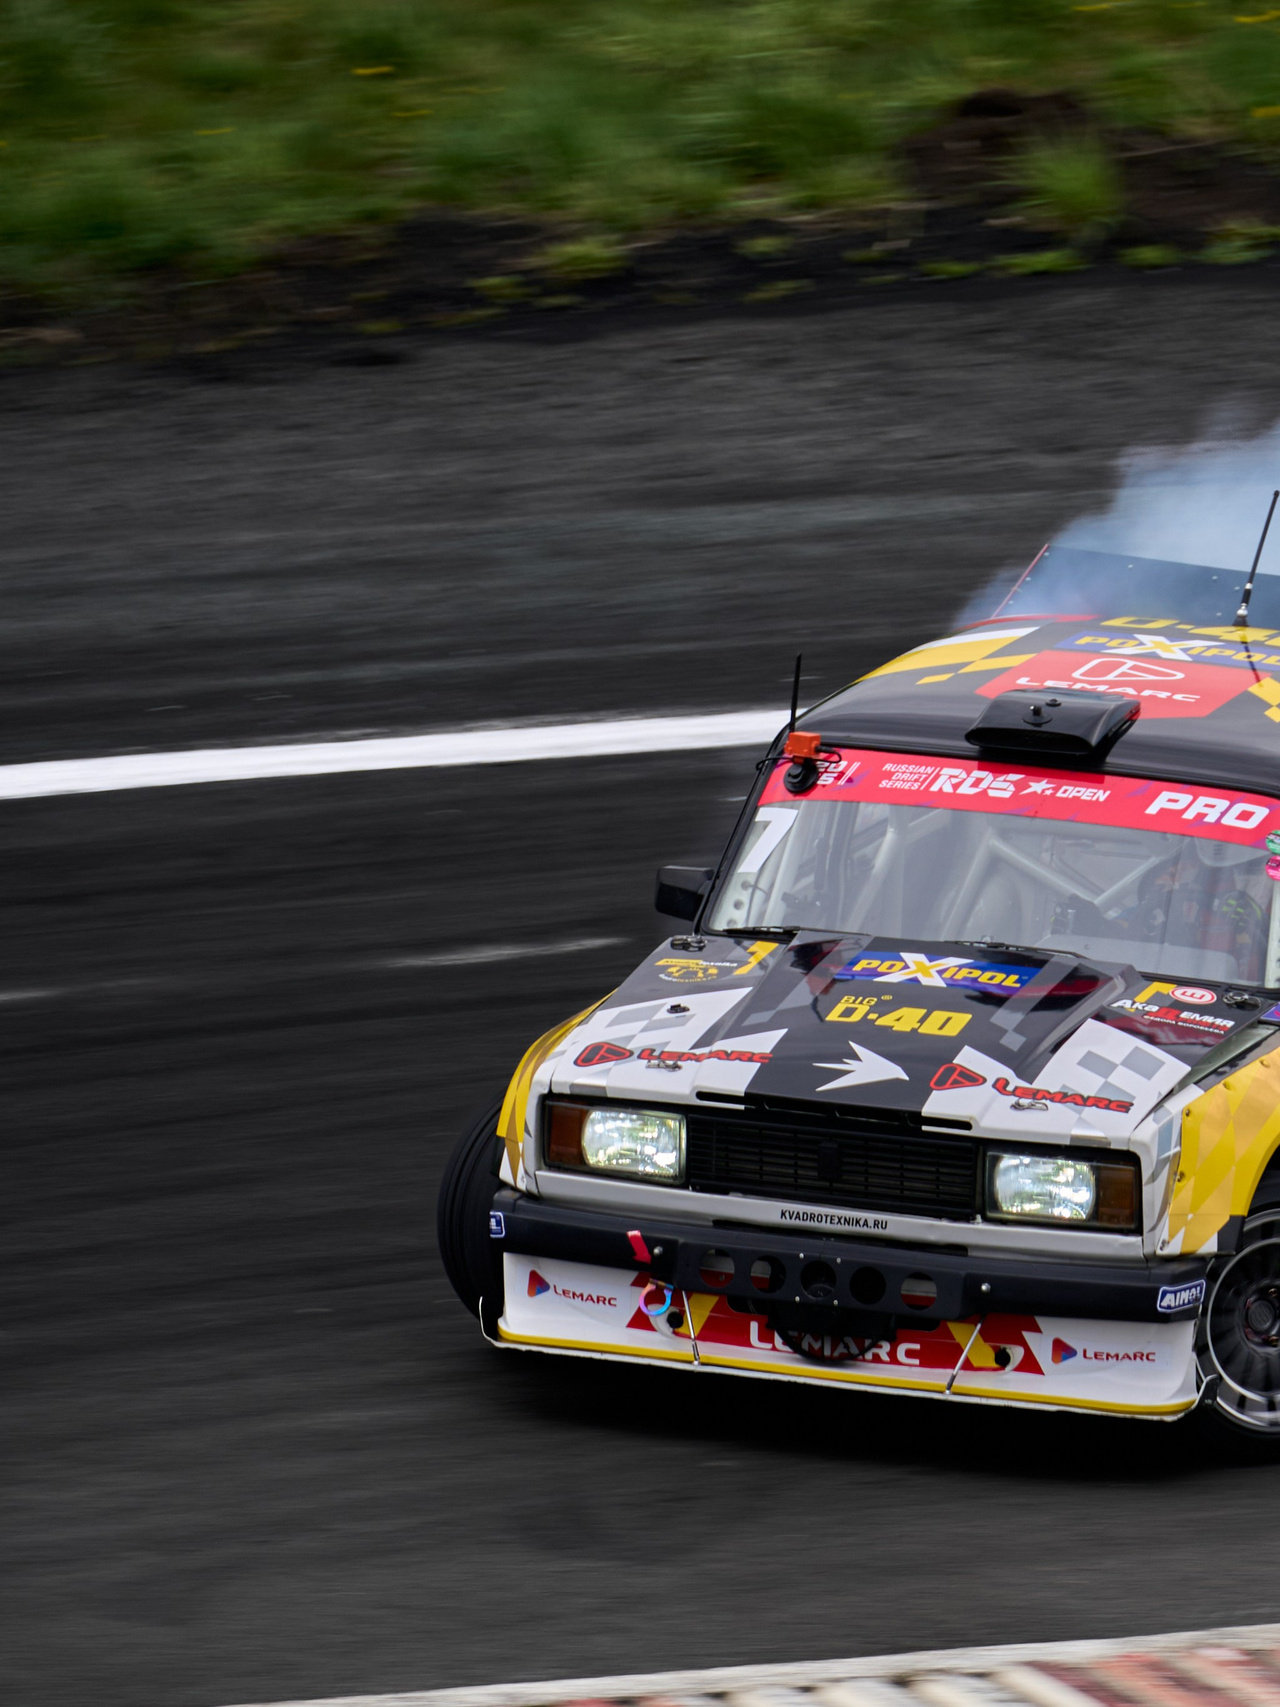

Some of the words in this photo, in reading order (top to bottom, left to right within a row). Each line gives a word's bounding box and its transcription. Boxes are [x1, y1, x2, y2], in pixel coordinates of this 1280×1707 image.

[1015, 676, 1201, 703] LEMARC
[881, 762, 935, 774] RUSSIAN
[893, 772, 928, 782] DRIFT
[816, 772, 838, 785] 5
[878, 780, 922, 790] SERIES
[929, 767, 1026, 798] RDS
[1055, 785, 1112, 802] OPEN
[1144, 790, 1270, 830] PRO
[852, 952, 1021, 988] POXIPOL
[840, 995, 878, 1006] BIG
[637, 1048, 773, 1063] LEMARC
[991, 1077, 1135, 1114] LEMARC
[780, 1209, 888, 1230] KVADROTEXNIKA.RU
[552, 1284, 618, 1307] LEMARC
[1082, 1348, 1156, 1362] LEMARC
